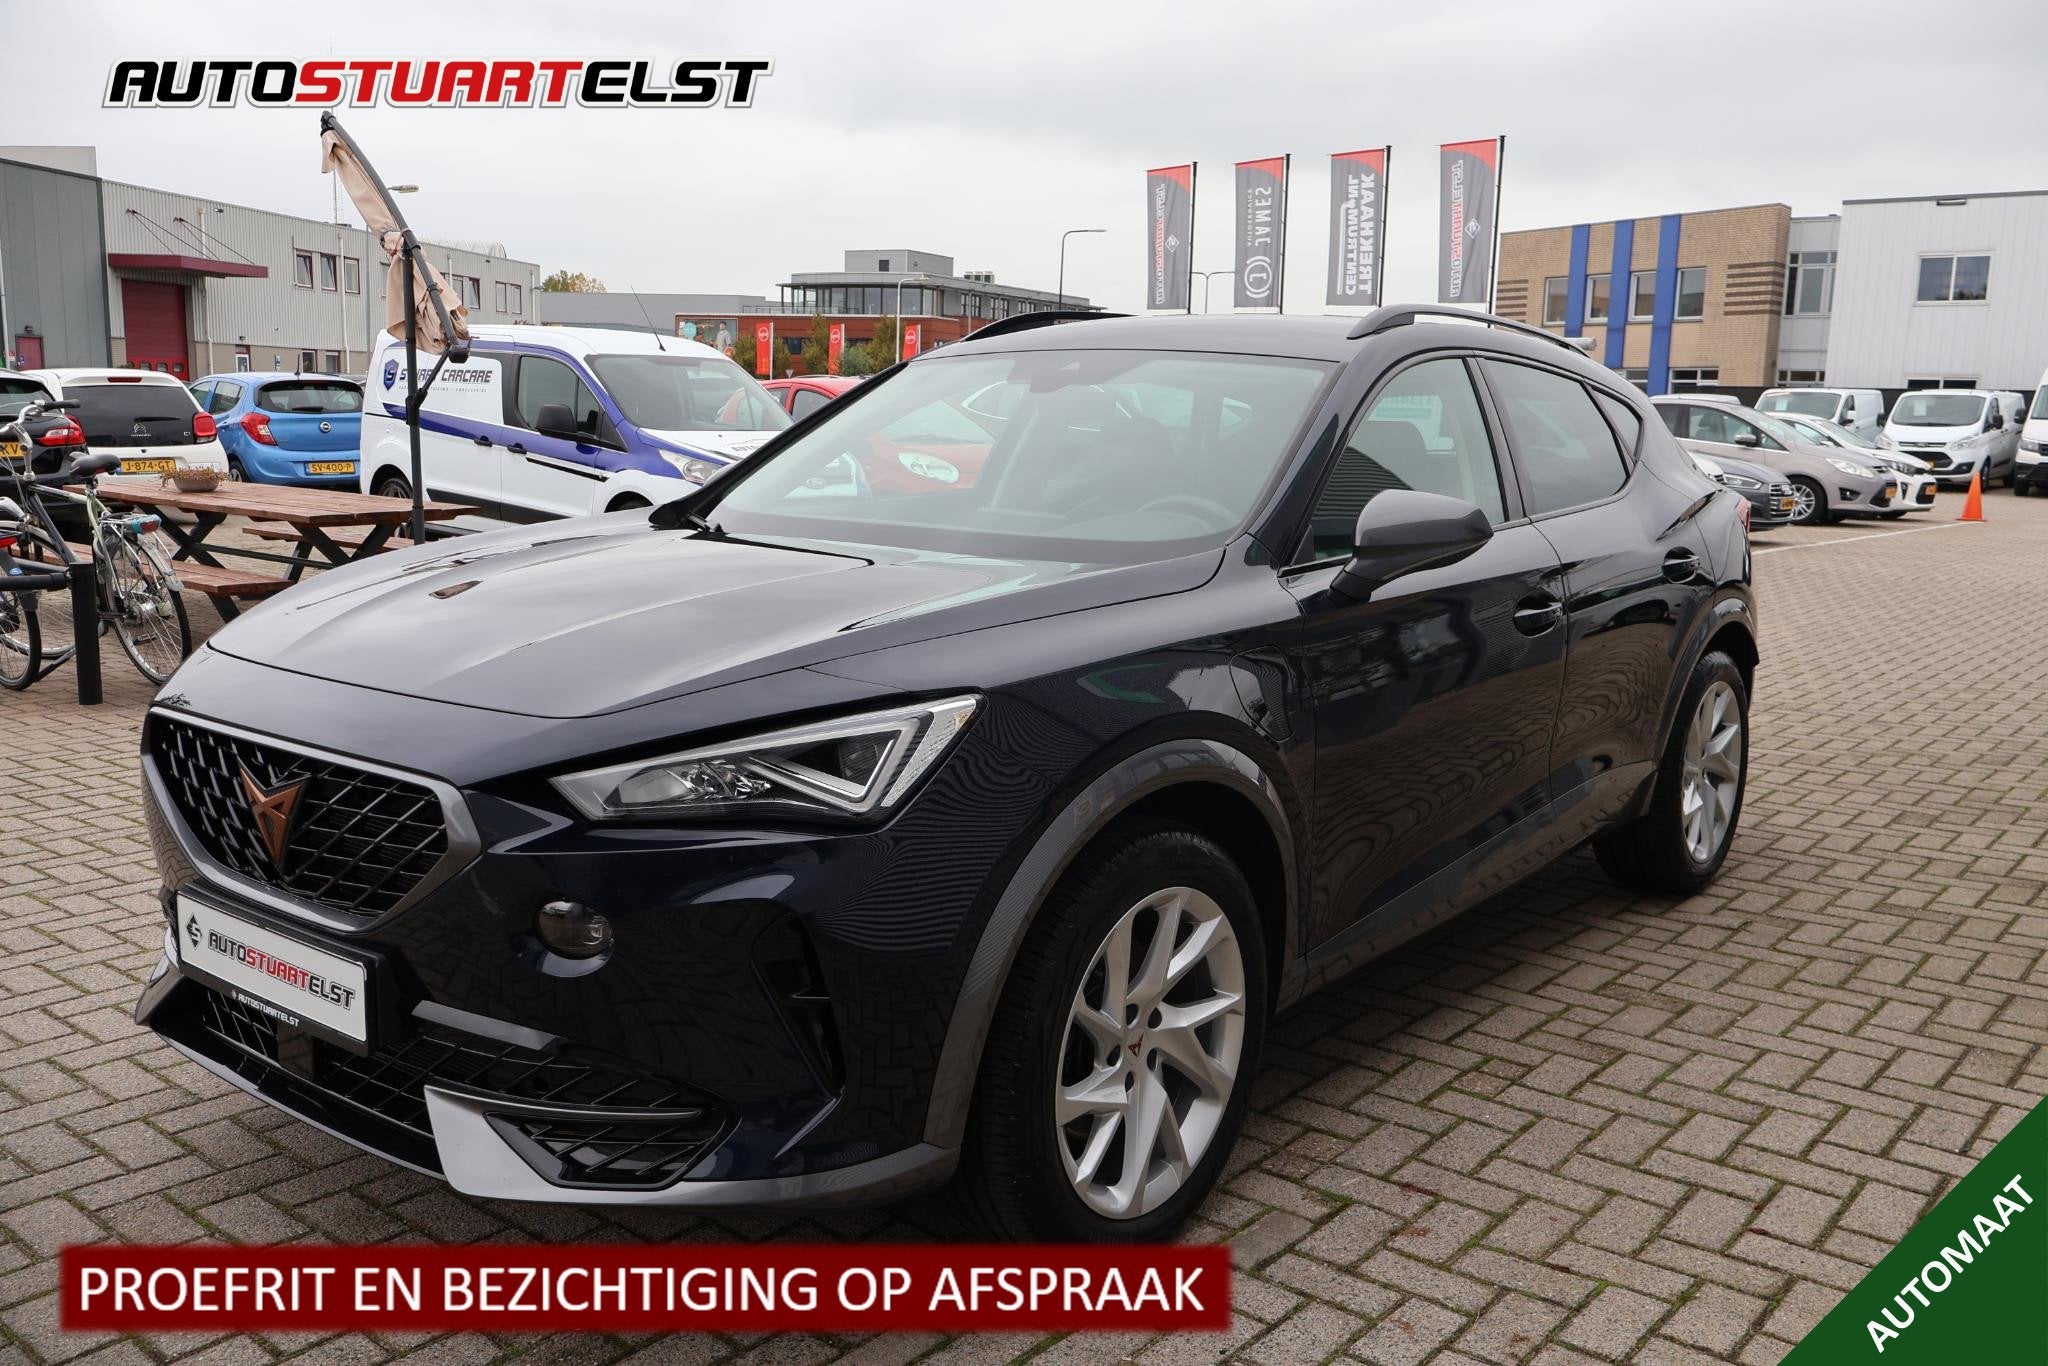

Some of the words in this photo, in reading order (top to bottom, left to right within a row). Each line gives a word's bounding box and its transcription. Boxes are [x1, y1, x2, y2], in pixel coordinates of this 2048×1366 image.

[441, 369, 493, 383] CARCARE
[125, 460, 170, 471] J-874-GT
[311, 463, 352, 472] SV-400-P
[207, 929, 355, 1011] AUTOSTUARTELST
[238, 992, 300, 1028] AUTOSTUARTELST
